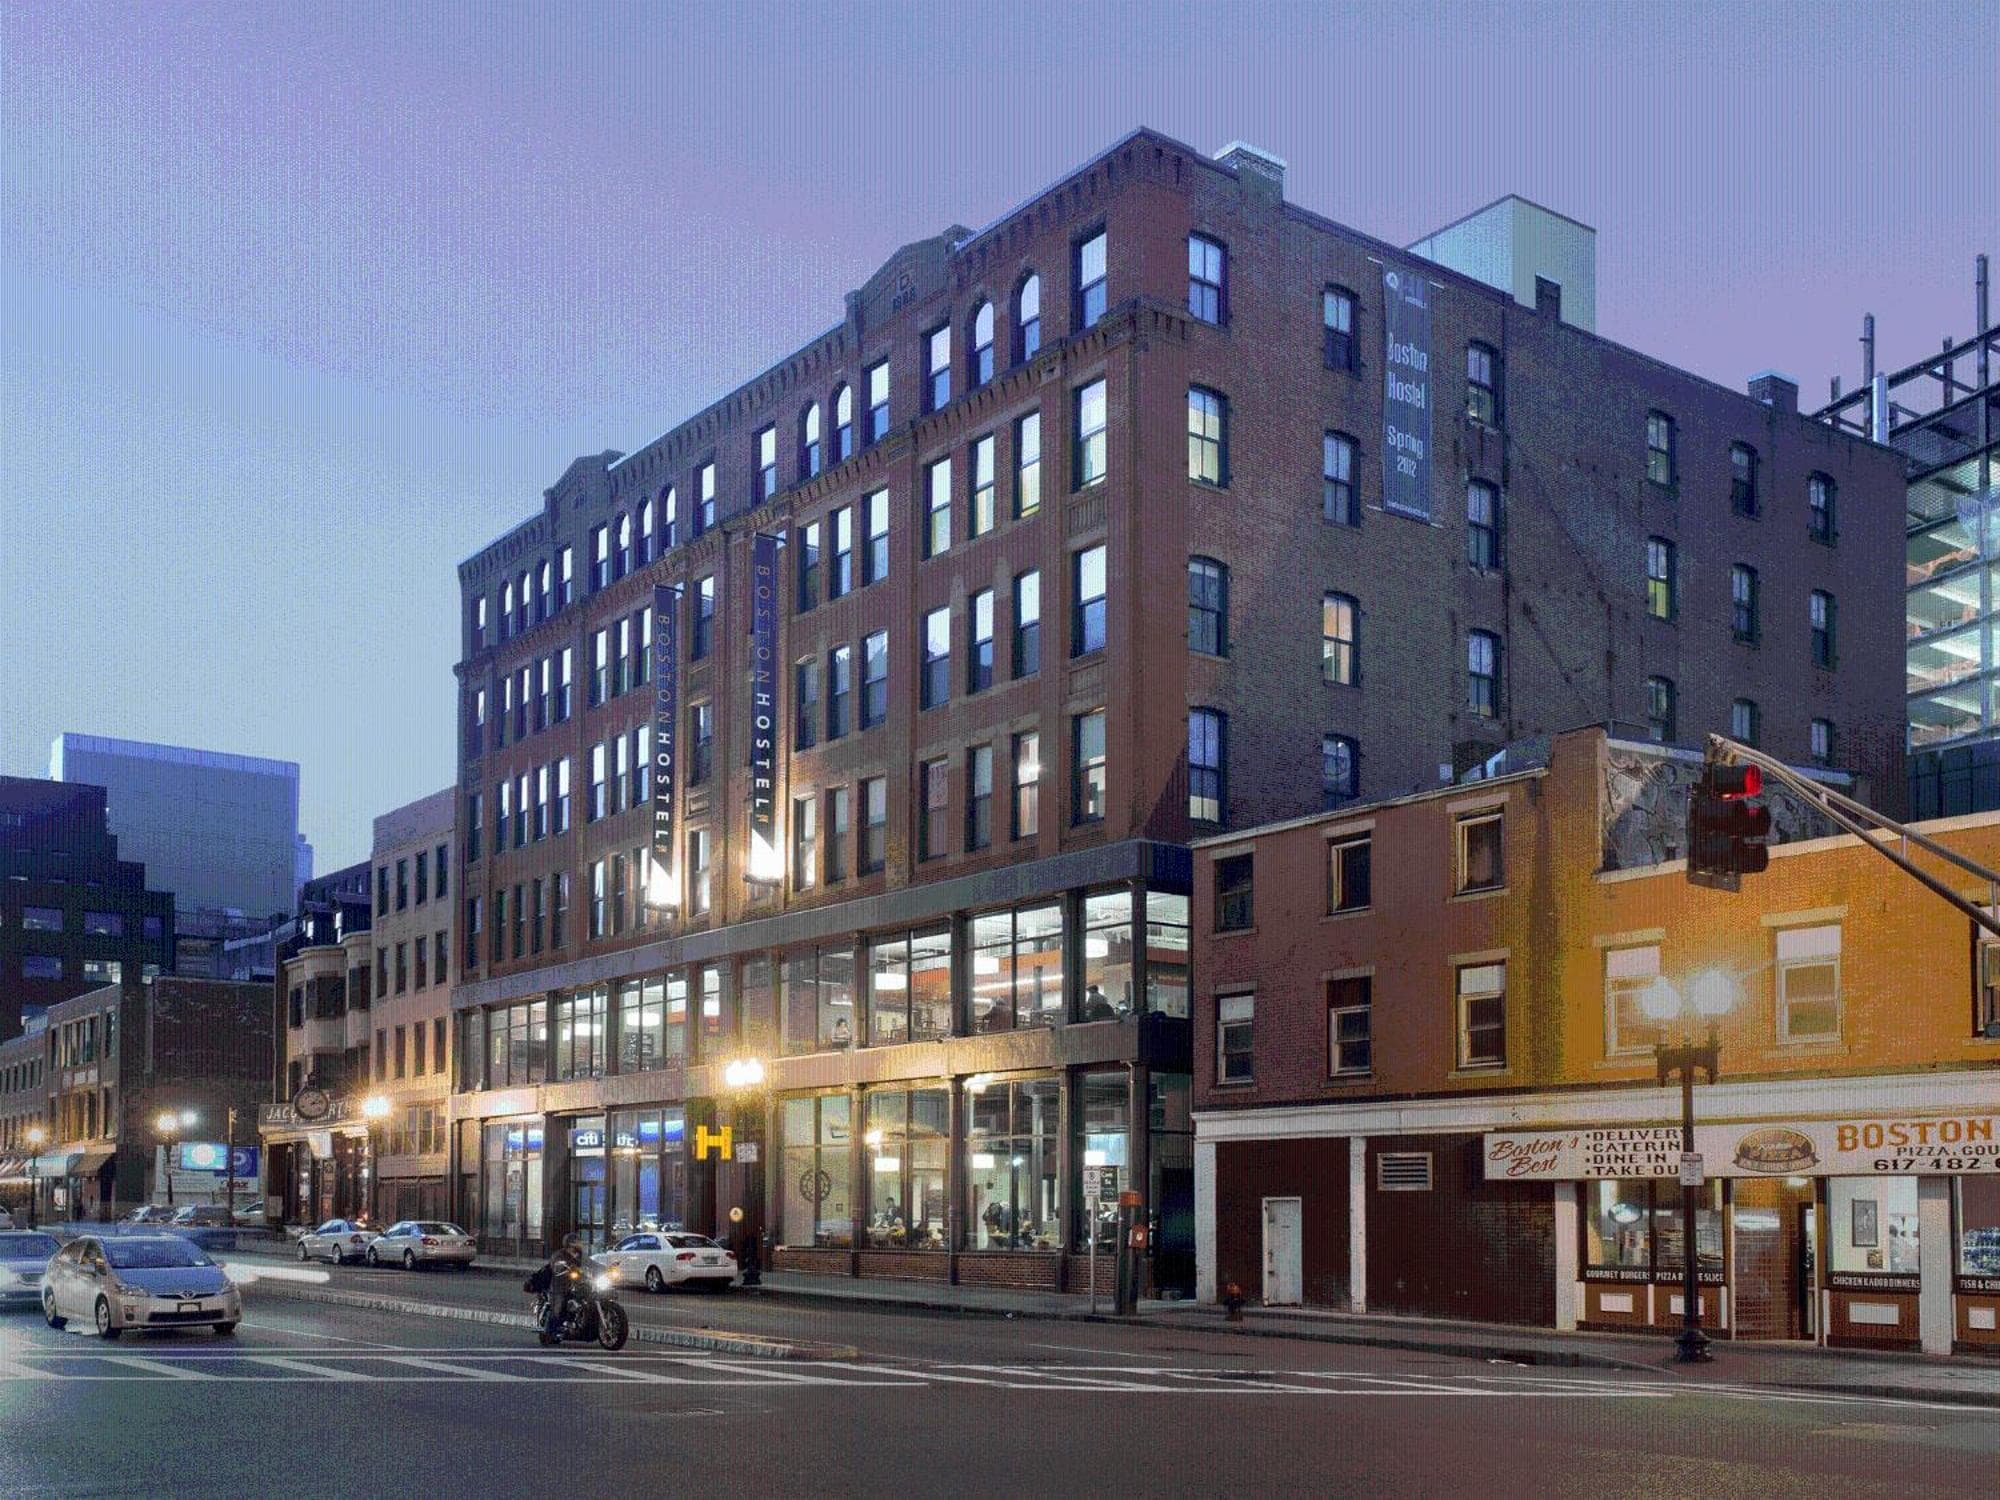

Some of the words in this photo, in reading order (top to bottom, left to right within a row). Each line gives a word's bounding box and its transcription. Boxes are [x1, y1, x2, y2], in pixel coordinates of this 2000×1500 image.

[1388, 332, 1428, 372] Boston
[1388, 371, 1426, 410] Hostel
[1388, 425, 1424, 460] Spring
[1397, 455, 1417, 478] 2012
[755, 693, 770, 807] HOSTEL
[655, 732, 671, 848] HOSTEL
[576, 1130, 598, 1146] citi
[1593, 1129, 1684, 1141] DELIVER
[1837, 1119, 1993, 1152] BOSTON
[1488, 1136, 1580, 1161] Boston's
[1593, 1141, 1681, 1153] CATERIN
[1506, 1156, 1559, 1177] Best
[1593, 1165, 1679, 1176] TAKE-OU
[1656, 1271, 1677, 1281] PIZZA
[1704, 1272, 1724, 1282] SLICE
[1960, 1279, 1977, 1289] FISH
